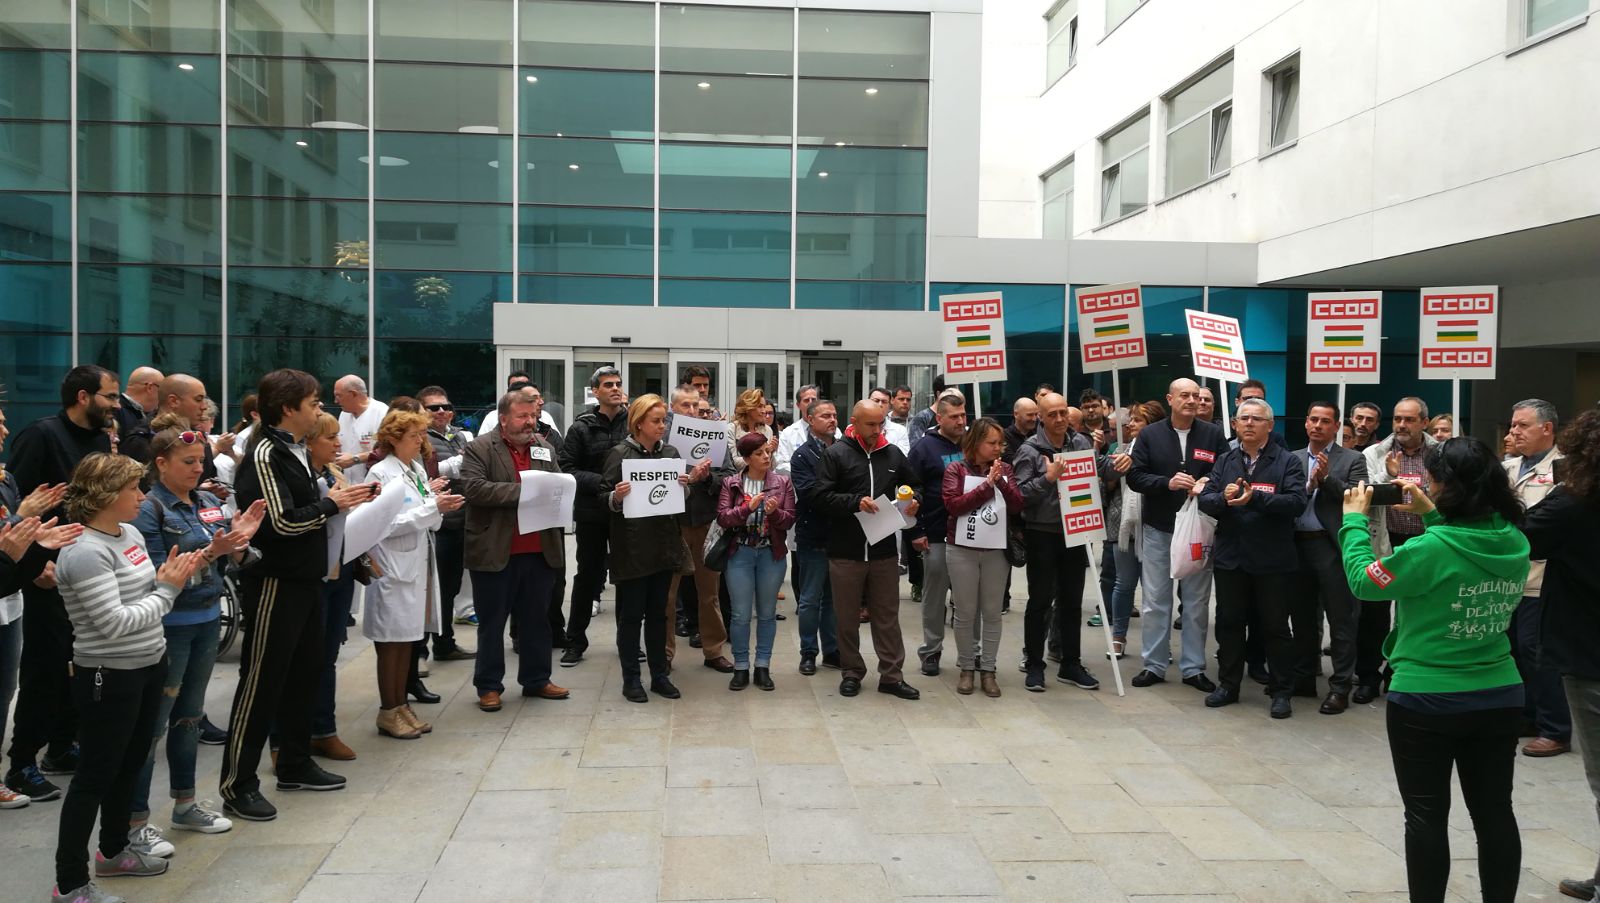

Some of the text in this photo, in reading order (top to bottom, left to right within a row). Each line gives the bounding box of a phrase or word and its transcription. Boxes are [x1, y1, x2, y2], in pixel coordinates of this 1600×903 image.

[1083, 292, 1136, 310] CCOO
[1427, 297, 1490, 311] CCOO
[947, 303, 998, 318] CCOO
[1315, 302, 1374, 316] CCOO
[1191, 319, 1236, 333] CCOO
[1088, 341, 1140, 358] CCOO
[950, 354, 1001, 369] CCOO
[1198, 356, 1243, 372] CCOO
[1313, 356, 1373, 368] CCOO
[1426, 351, 1488, 364] CCOO
[677, 426, 724, 440] RESPETO
[630, 471, 678, 481] RESPETO
[1067, 513, 1102, 530] CCOO
[1458, 581, 1501, 597] ESCUELA
[1466, 607, 1484, 618] DE
